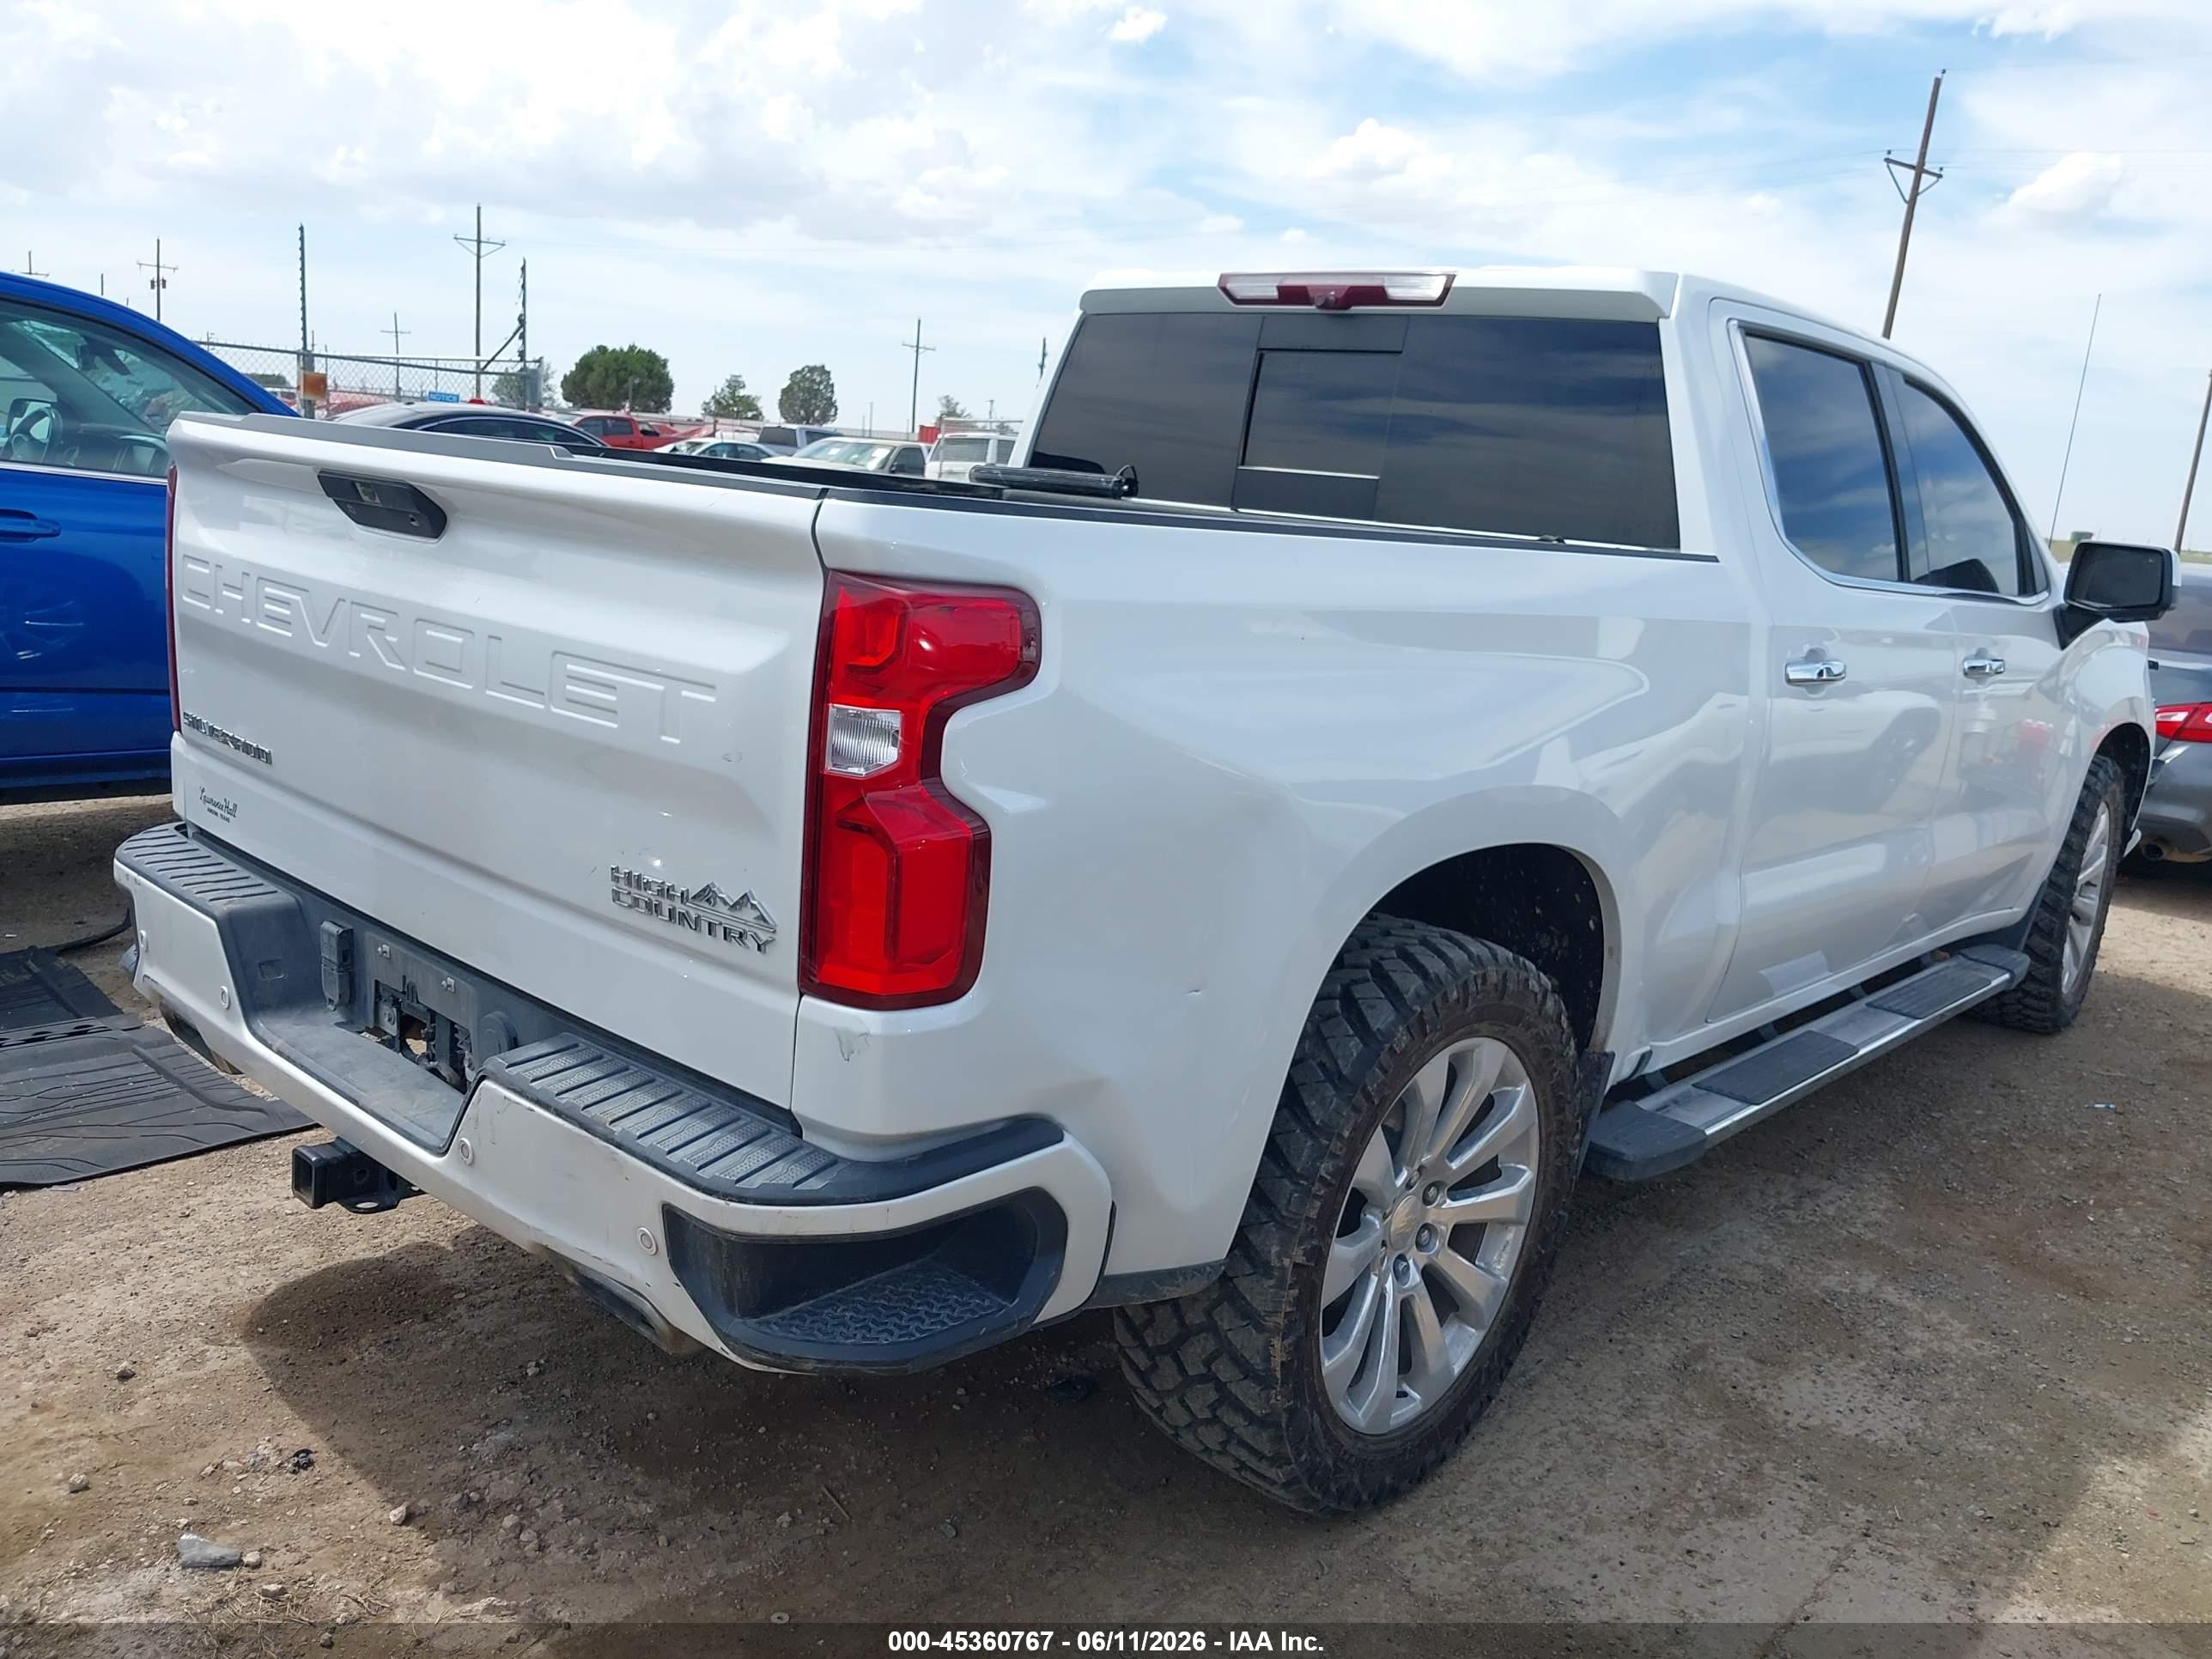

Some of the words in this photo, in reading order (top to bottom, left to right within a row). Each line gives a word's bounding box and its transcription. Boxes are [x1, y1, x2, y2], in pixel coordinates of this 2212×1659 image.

[182, 553, 716, 743] CHEVROLET
[611, 865, 690, 904] HIGH
[611, 885, 776, 953] COUNTRY
